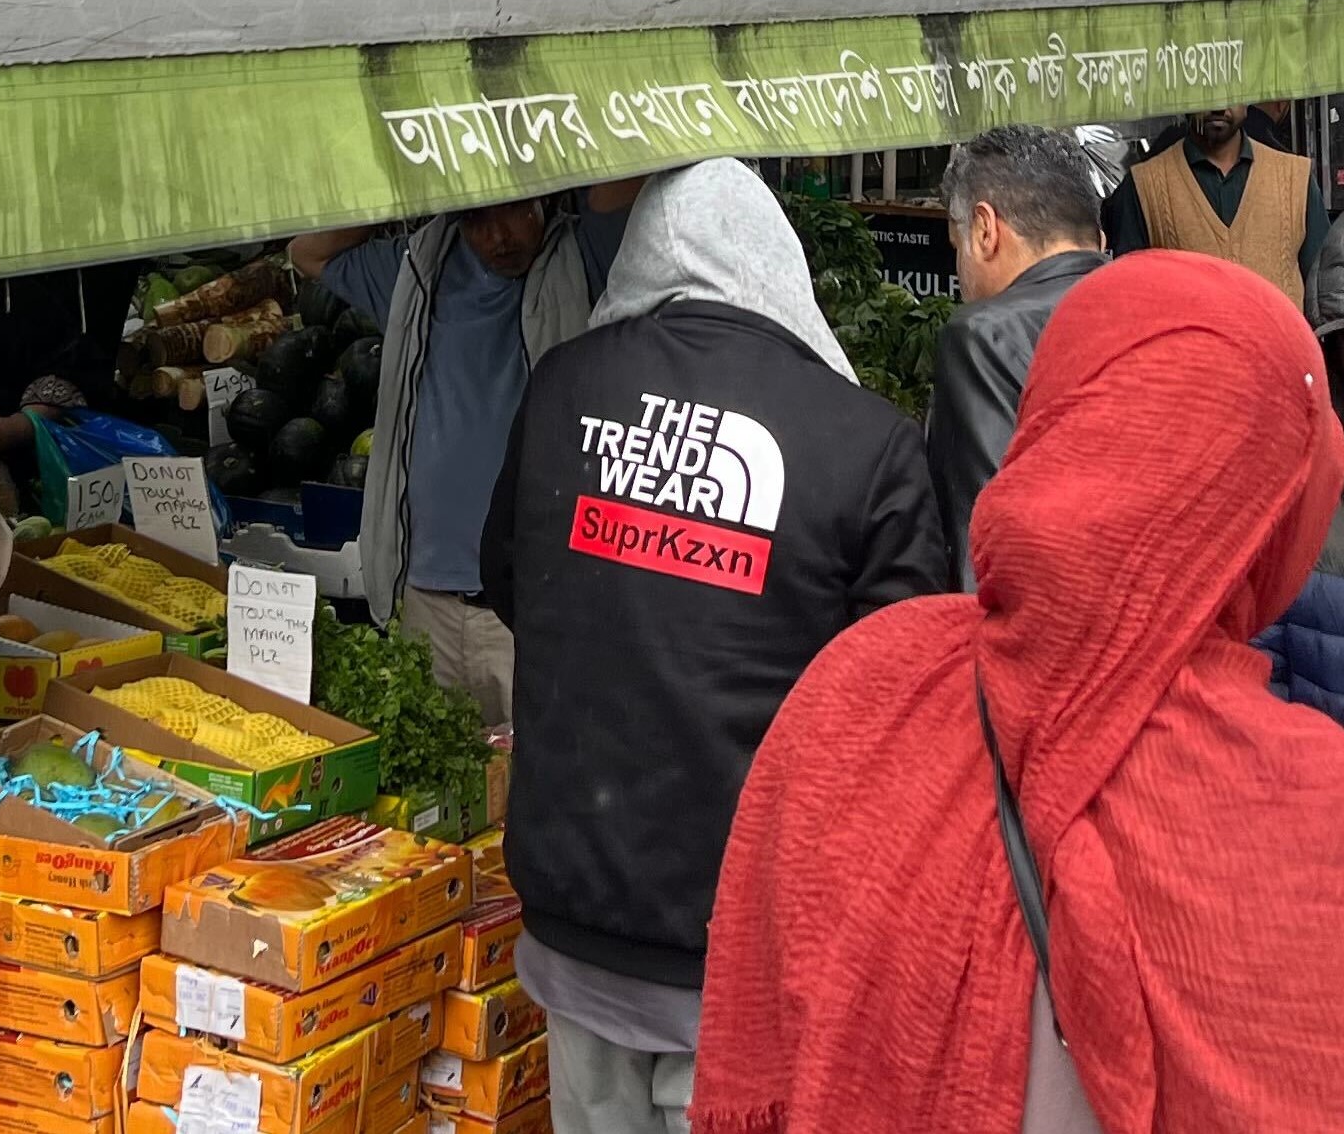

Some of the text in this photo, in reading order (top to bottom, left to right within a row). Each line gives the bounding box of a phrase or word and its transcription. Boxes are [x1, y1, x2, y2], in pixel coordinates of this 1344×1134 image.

[381, 92, 599, 175] আমাদের
[602, 80, 739, 146] এখানে
[885, 55, 960, 118] তাজা
[897, 232, 930, 245] TASTE
[898, 270, 961, 301] KULF
[580, 415, 707, 477] TREND
[640, 392, 719, 443] THE
[600, 456, 716, 519] WEAR
[581, 506, 754, 578] SuprKzxn
